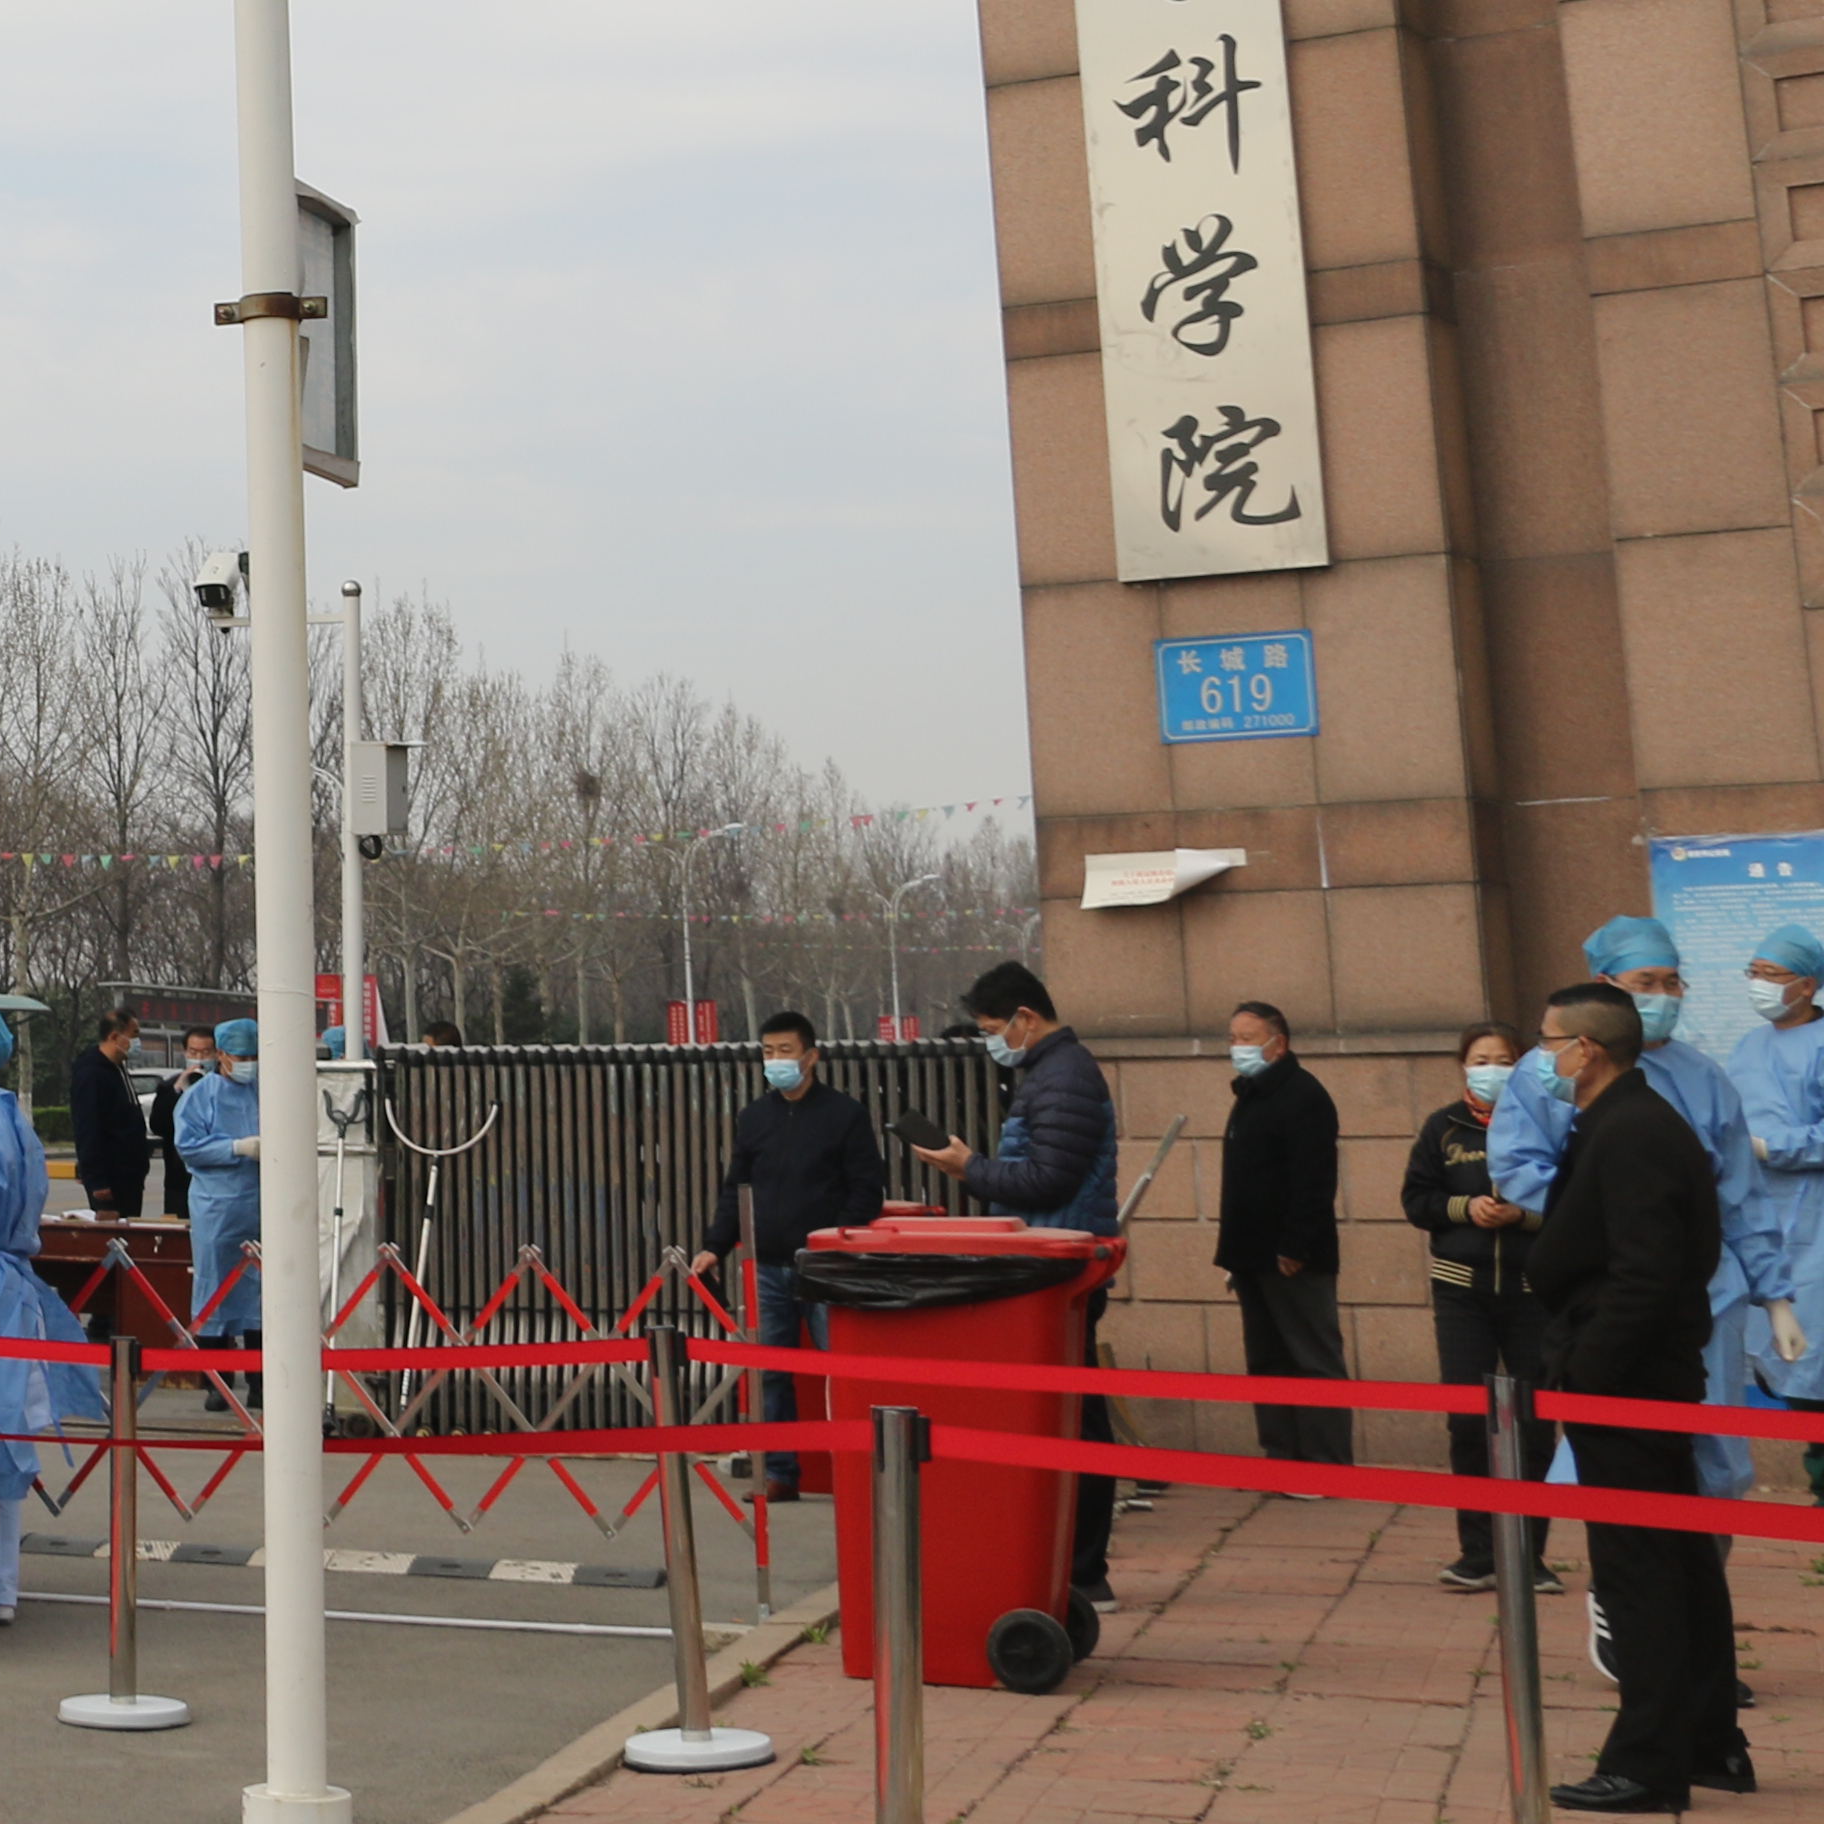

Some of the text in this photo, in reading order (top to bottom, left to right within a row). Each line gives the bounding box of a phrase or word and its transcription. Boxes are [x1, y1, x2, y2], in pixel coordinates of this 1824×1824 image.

[1177, 643, 1289, 675] 长城路
[1200, 673, 1274, 714] 619
[1243, 712, 1296, 729] 271000
